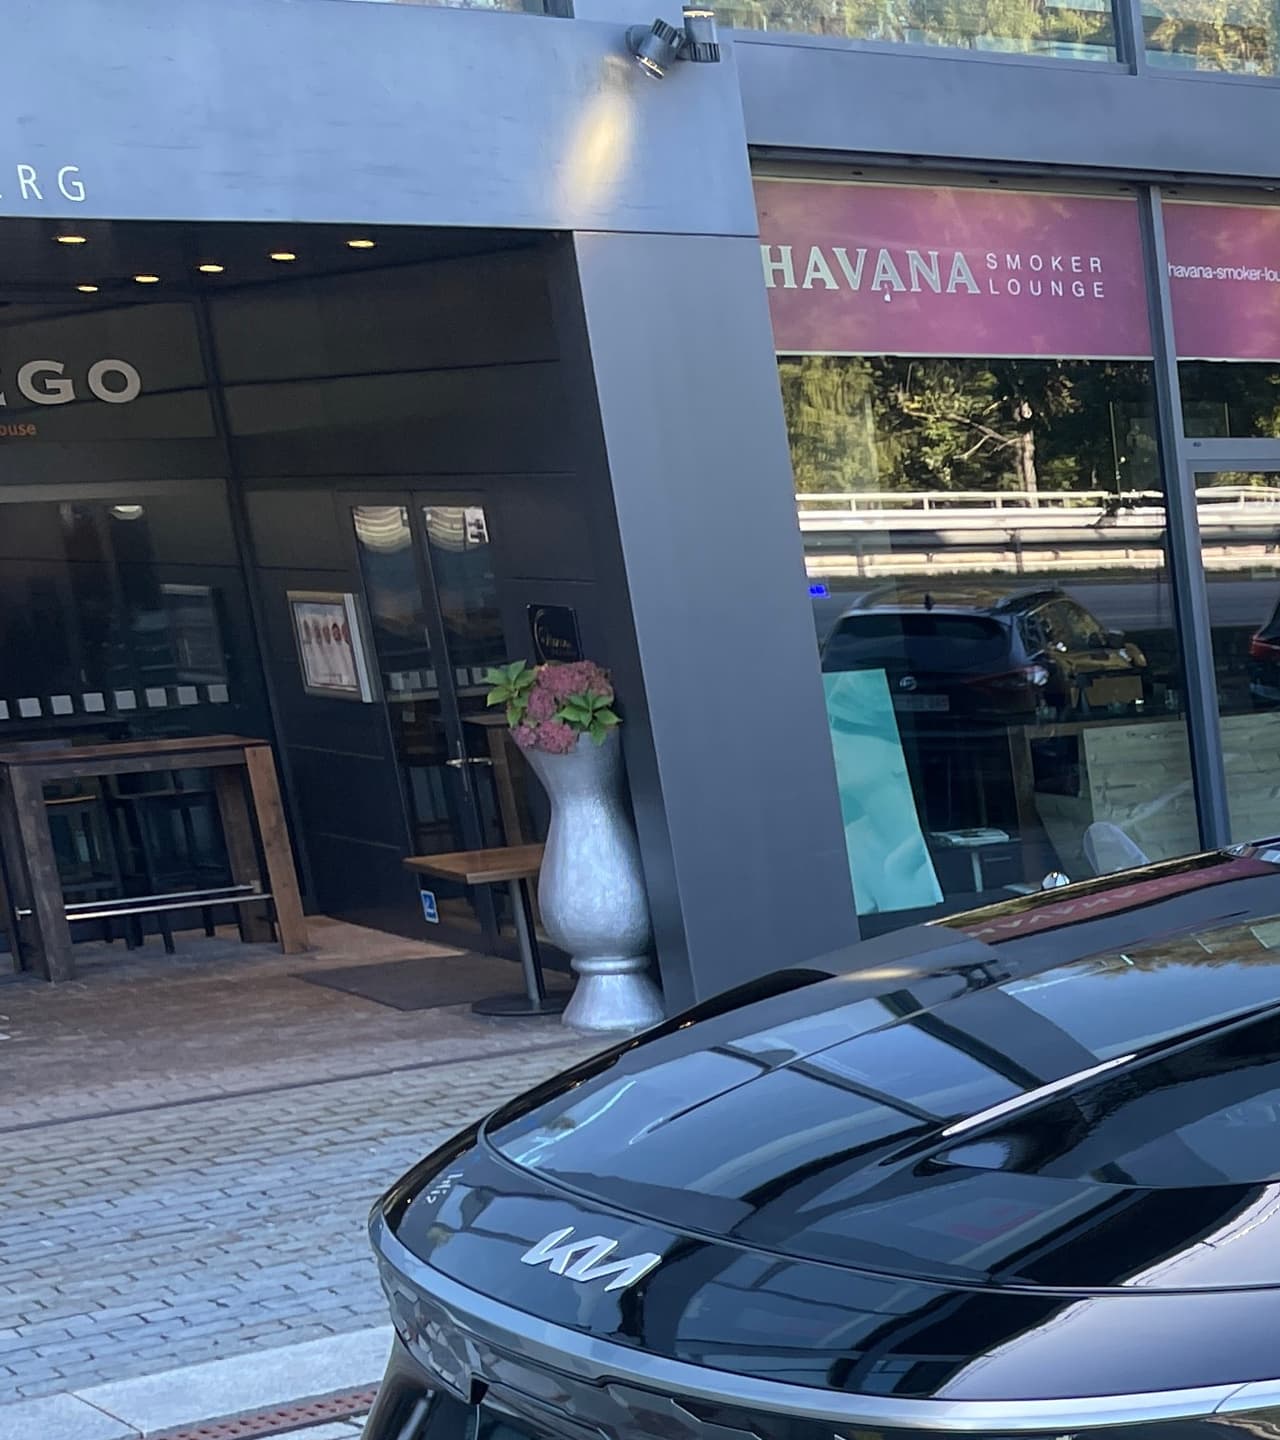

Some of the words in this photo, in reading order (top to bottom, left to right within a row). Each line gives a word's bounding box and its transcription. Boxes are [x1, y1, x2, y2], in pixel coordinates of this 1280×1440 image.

[0, 164, 86, 201] RG
[760, 245, 981, 295] HAVANA
[985, 252, 1103, 273] SMOKER
[988, 278, 1105, 299] LOUNGE
[0, 359, 141, 406] GO
[0, 422, 37, 437] ouse
[520, 1226, 663, 1293] KIA
